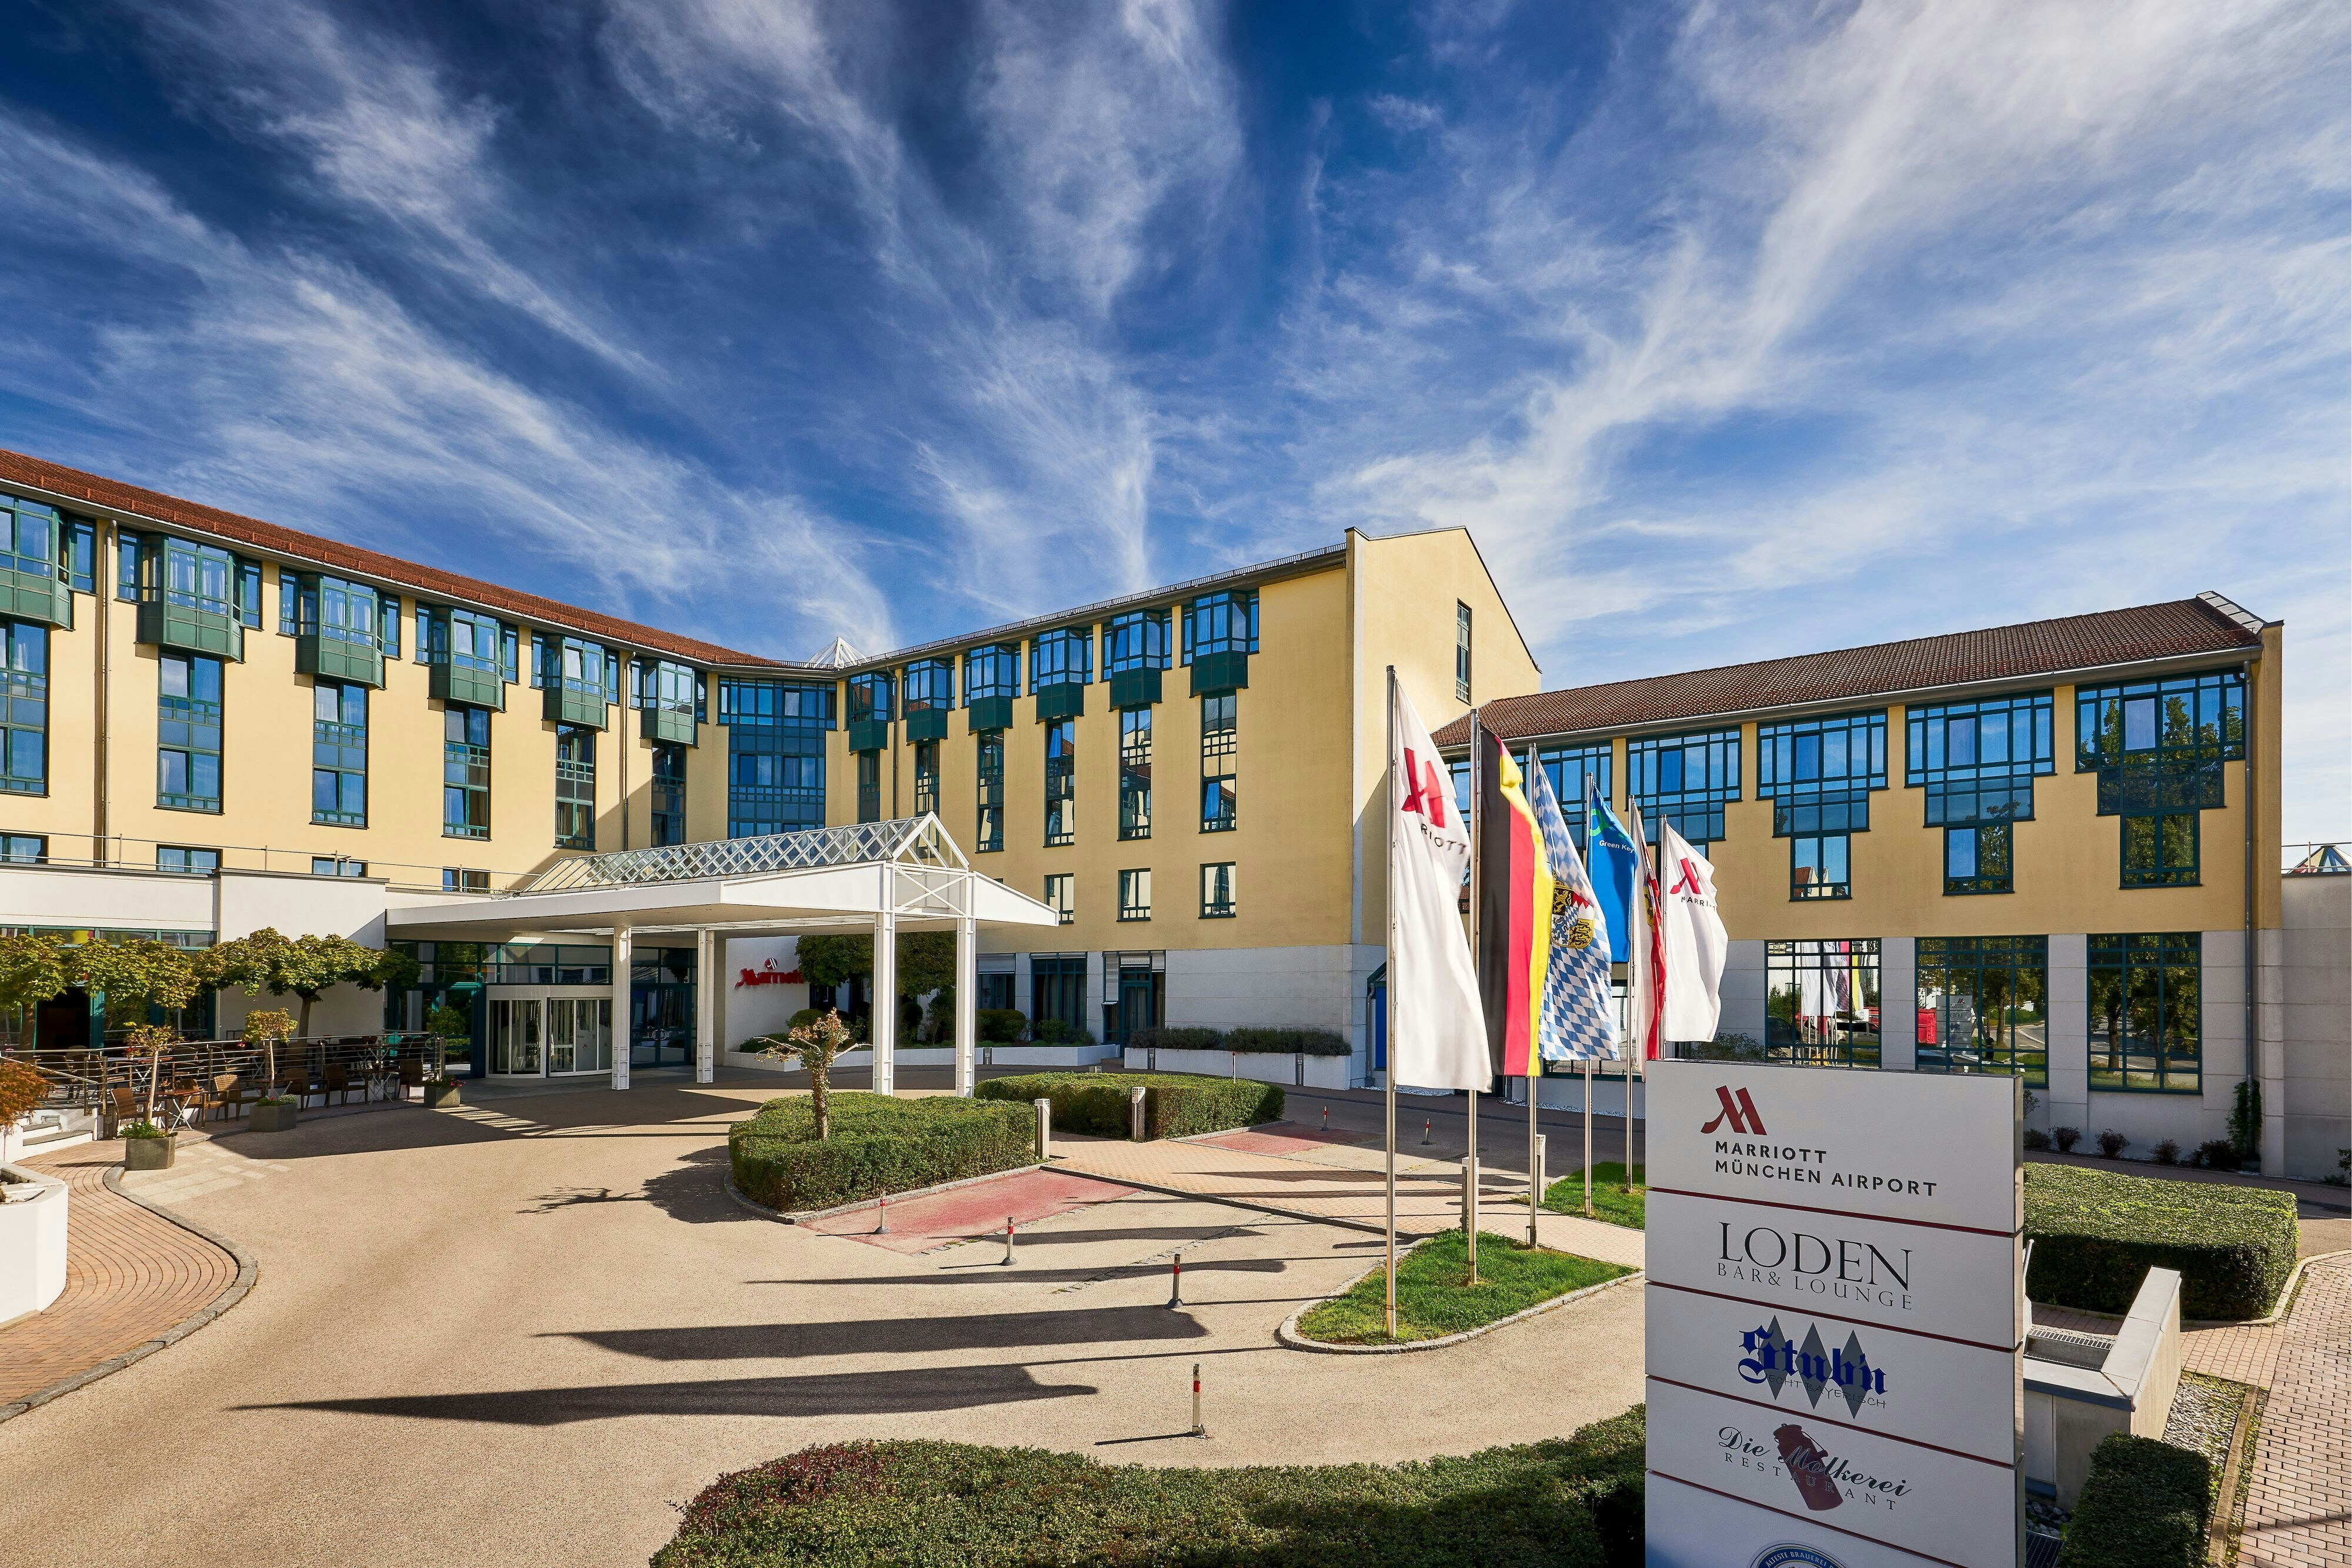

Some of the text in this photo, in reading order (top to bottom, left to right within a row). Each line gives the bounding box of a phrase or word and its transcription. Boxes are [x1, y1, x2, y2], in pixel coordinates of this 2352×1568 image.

[1421, 823, 1468, 855] RIOTT
[1599, 840, 1635, 854] Green Key
[1715, 1140, 1827, 1164] MARRIOTT
[1715, 1159, 1937, 1196] MÜNCHEN AIRPORT
[1719, 1221, 1913, 1292] LODEN
[1795, 1276, 1912, 1310] LOUNGE
[1769, 1374, 1886, 1409] ECHT BAYERISCH
[1718, 1426, 1912, 1497] Die Molkerei
[1725, 1452, 1896, 1510] RESTAURANT
[1765, 1551, 1827, 1568] ÄLTESTE BRAUEREI
